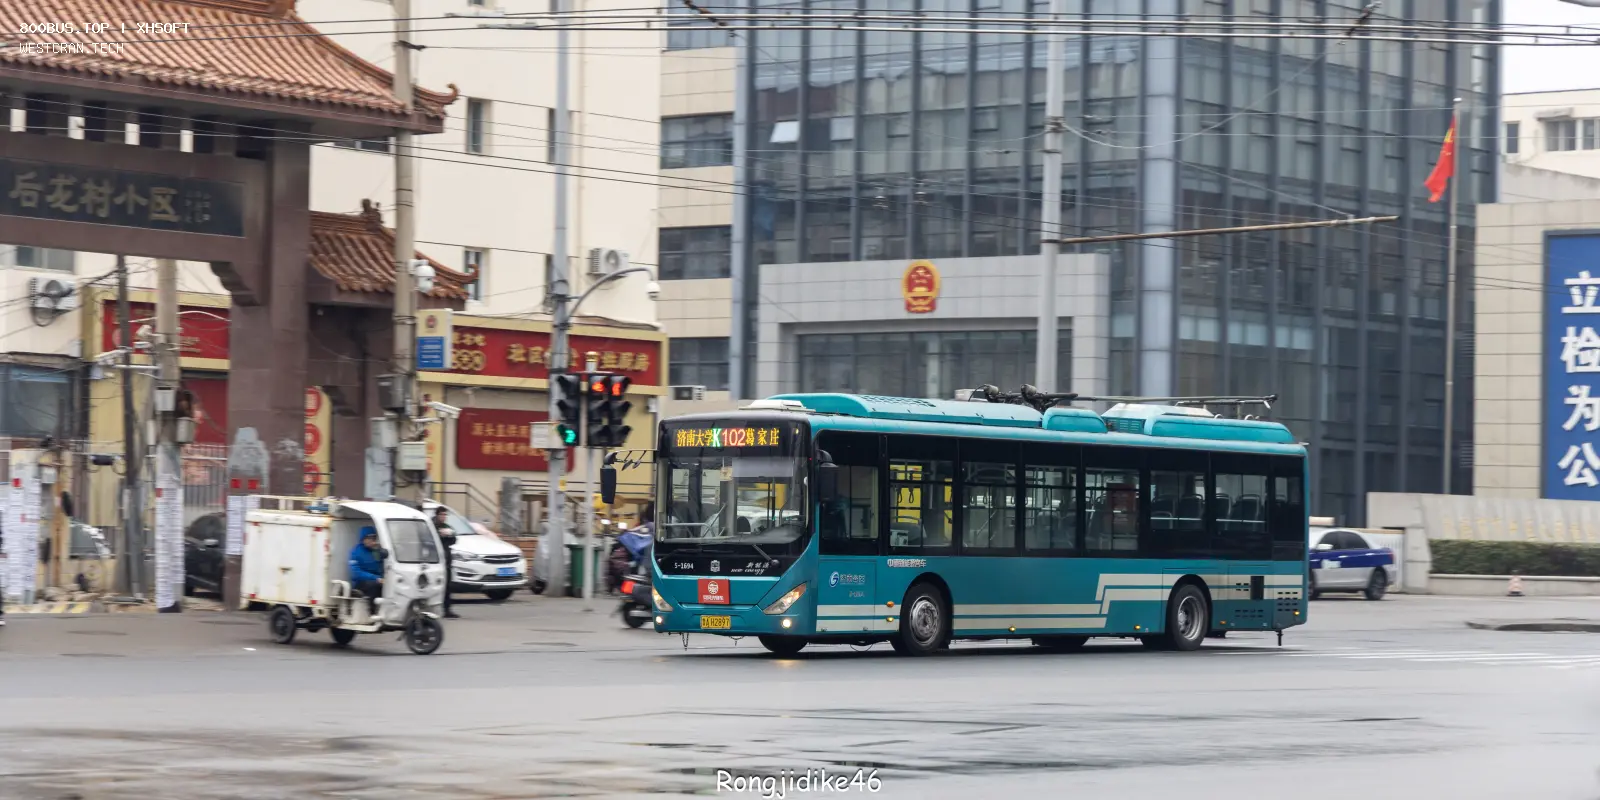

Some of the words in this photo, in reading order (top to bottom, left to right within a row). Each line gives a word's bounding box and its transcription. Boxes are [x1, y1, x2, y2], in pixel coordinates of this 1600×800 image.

[677, 429, 713, 447] 济南大学
[1557, 270, 1600, 488] 立检为公
